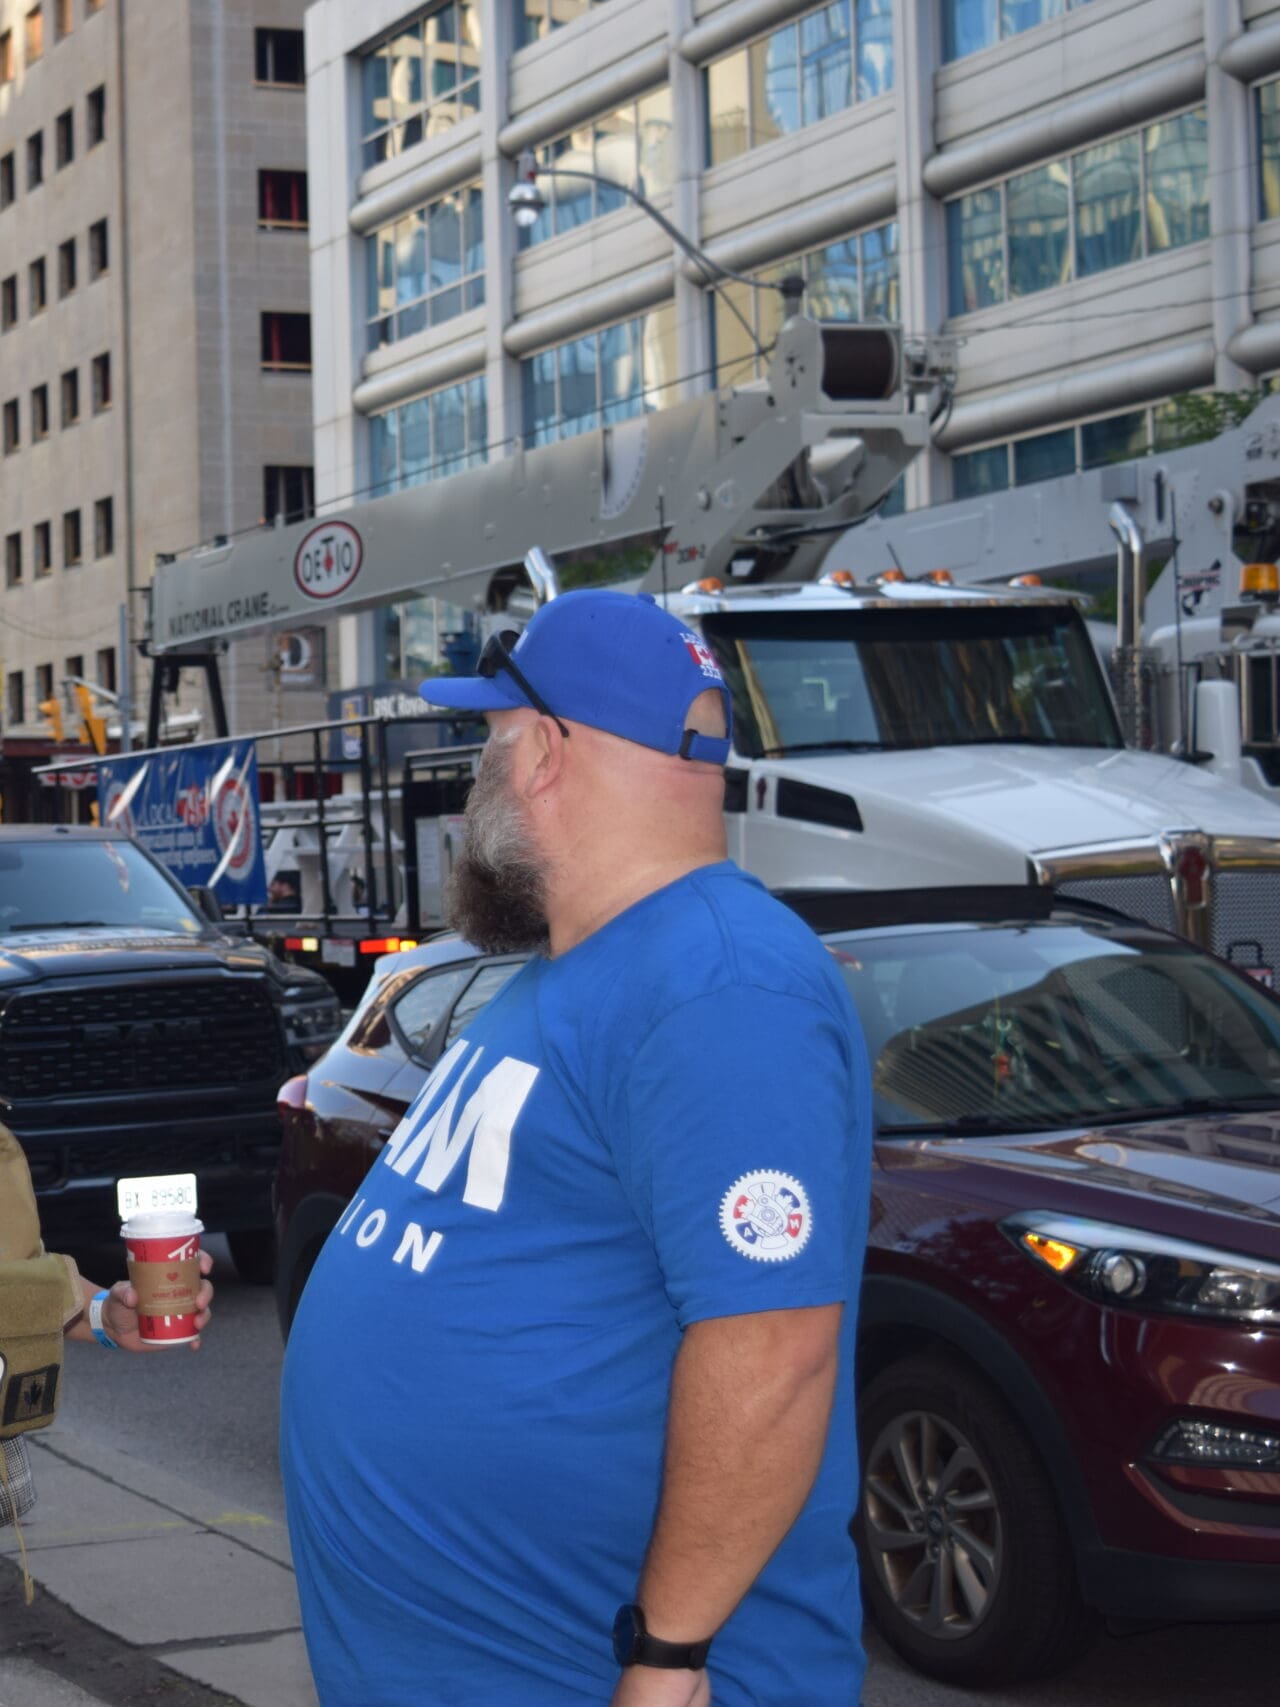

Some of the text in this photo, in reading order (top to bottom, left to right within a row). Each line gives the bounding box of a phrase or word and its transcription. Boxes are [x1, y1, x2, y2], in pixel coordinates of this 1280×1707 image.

[169, 592, 269, 637] NATIONAL CRANE
[336, 1193, 443, 1273] ION
